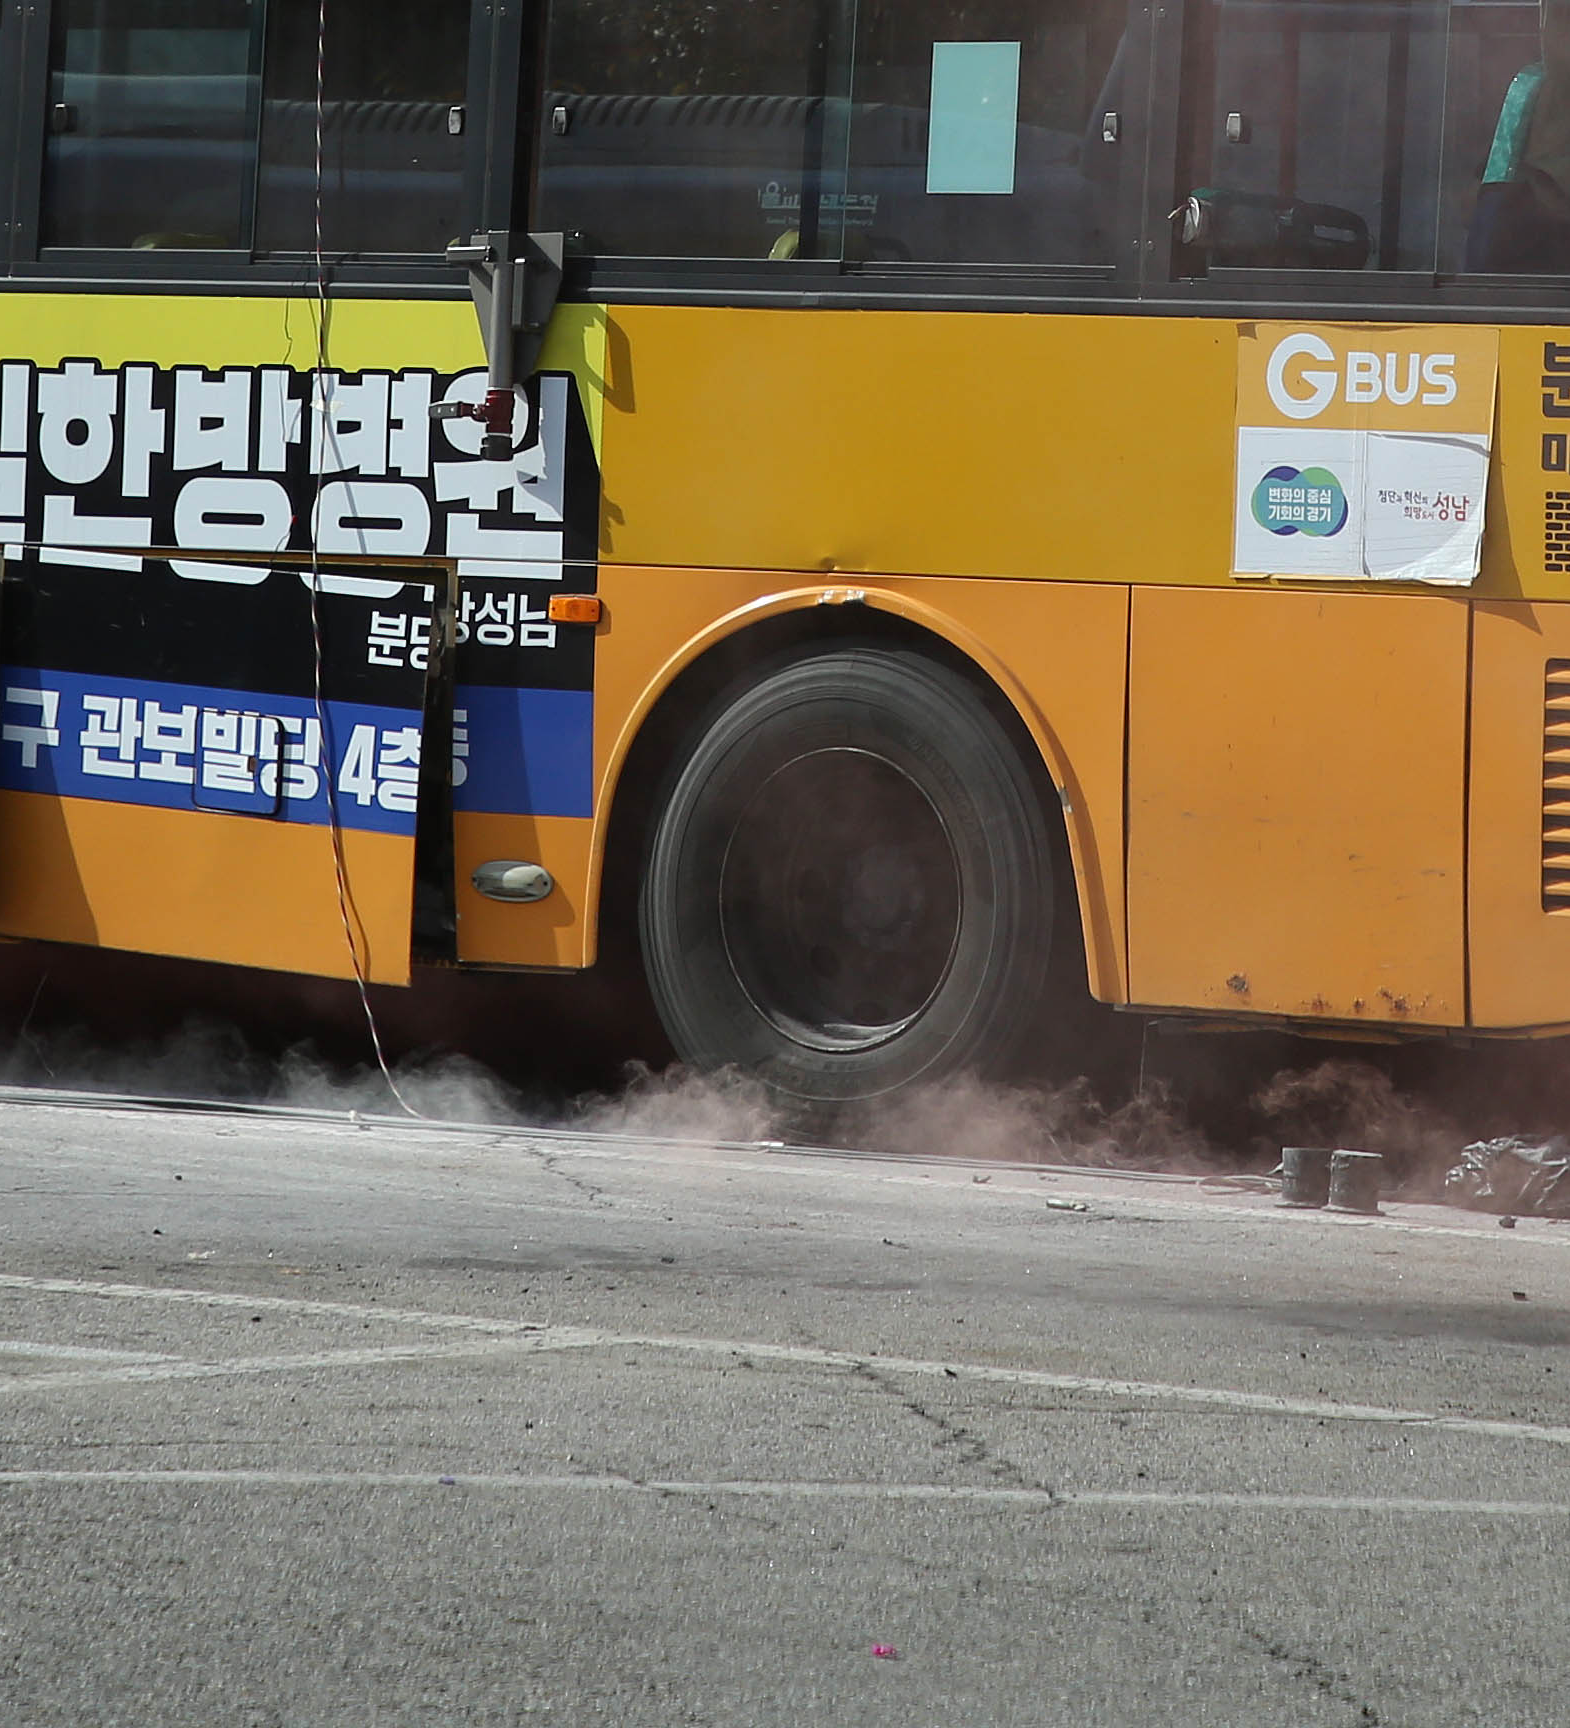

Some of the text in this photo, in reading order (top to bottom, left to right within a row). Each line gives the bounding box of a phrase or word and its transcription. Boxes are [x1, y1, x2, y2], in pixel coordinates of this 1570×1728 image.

[1268, 487, 1332, 505] 변화의 중심
[1268, 505, 1332, 522] 기회의 경기
[1432, 491, 1470, 522] 성남
